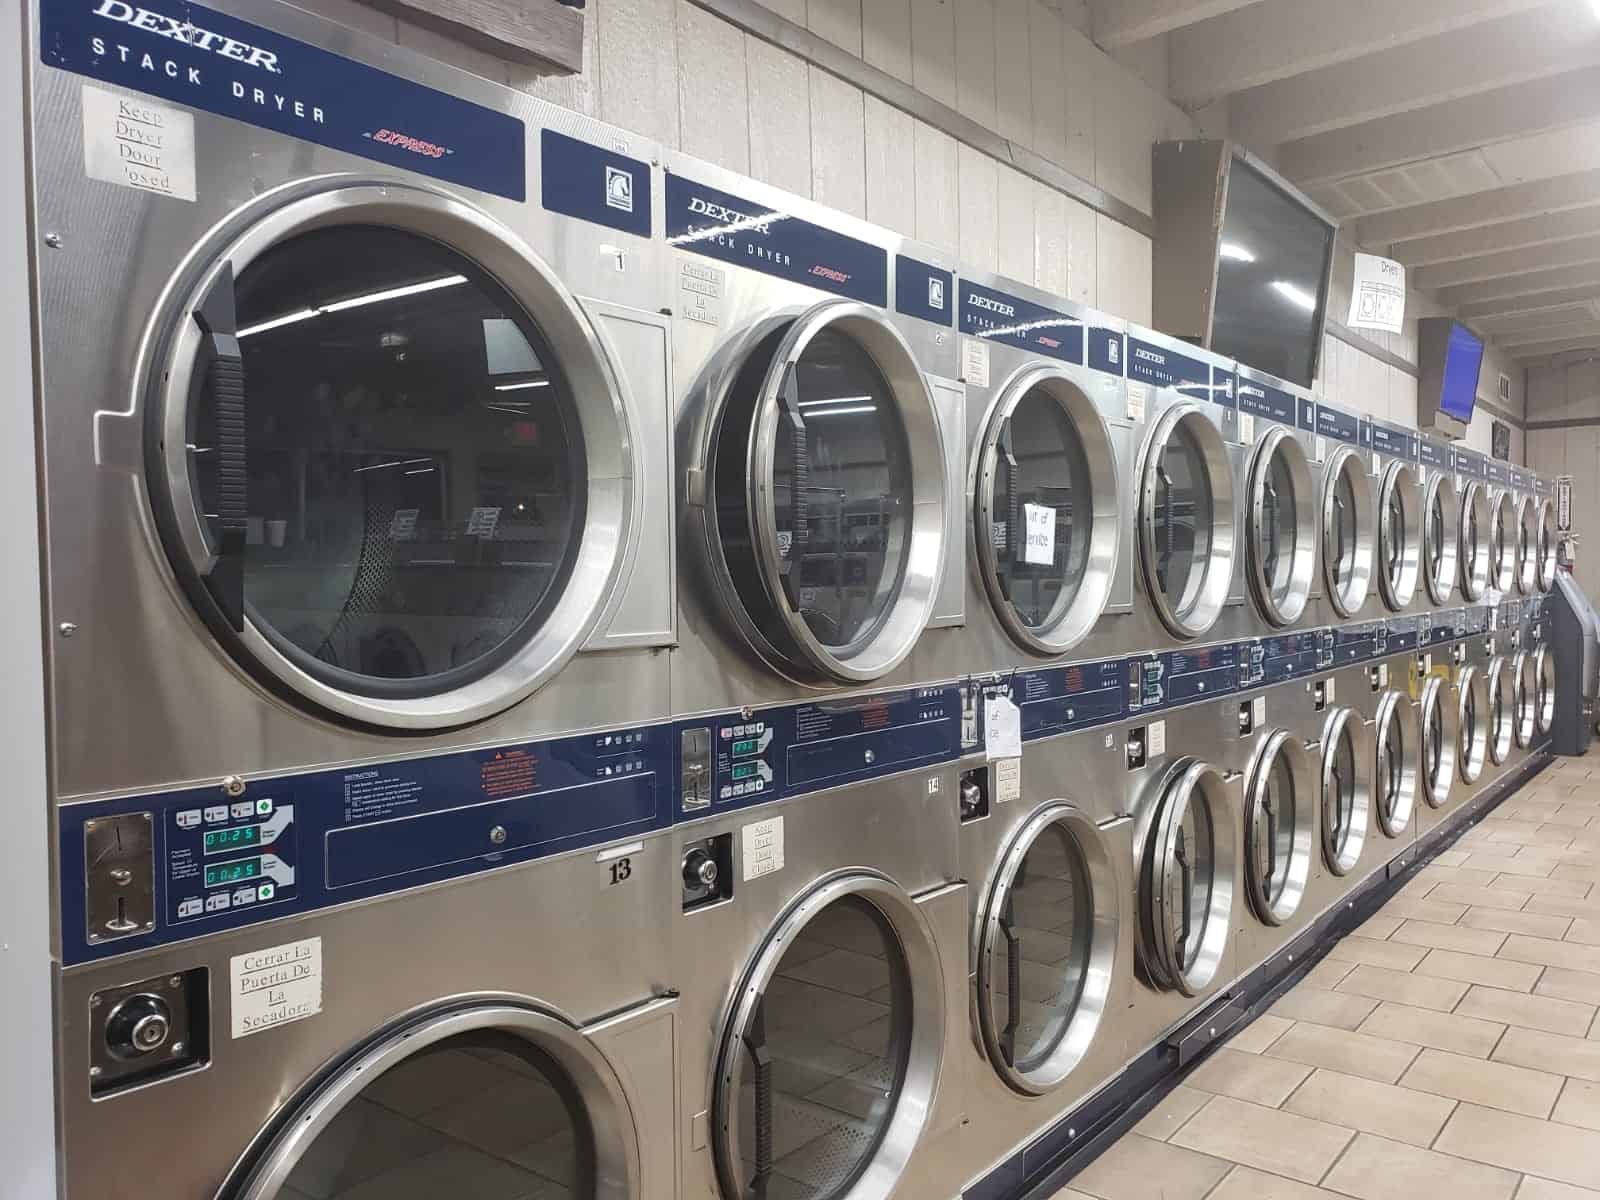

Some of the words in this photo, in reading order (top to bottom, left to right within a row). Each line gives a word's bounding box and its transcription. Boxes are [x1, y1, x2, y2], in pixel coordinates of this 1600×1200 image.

[92, 0, 278, 74] DEXTER
[91, 37, 201, 85] STACK
[231, 80, 324, 124] DRYER
[119, 99, 163, 126] Keep
[115, 119, 162, 146] Dryer
[373, 128, 445, 158] EXPRESS
[119, 142, 161, 169] Door
[687, 197, 771, 235] DEXTR
[747, 243, 791, 267] DRYER
[967, 293, 1015, 318] DEXTER
[608, 857, 632, 886] 13
[243, 950, 290, 971] Cerrar
[294, 945, 311, 959] La
[241, 970, 288, 992] Puerta
[292, 963, 311, 978] De
[267, 990, 285, 1003] La
